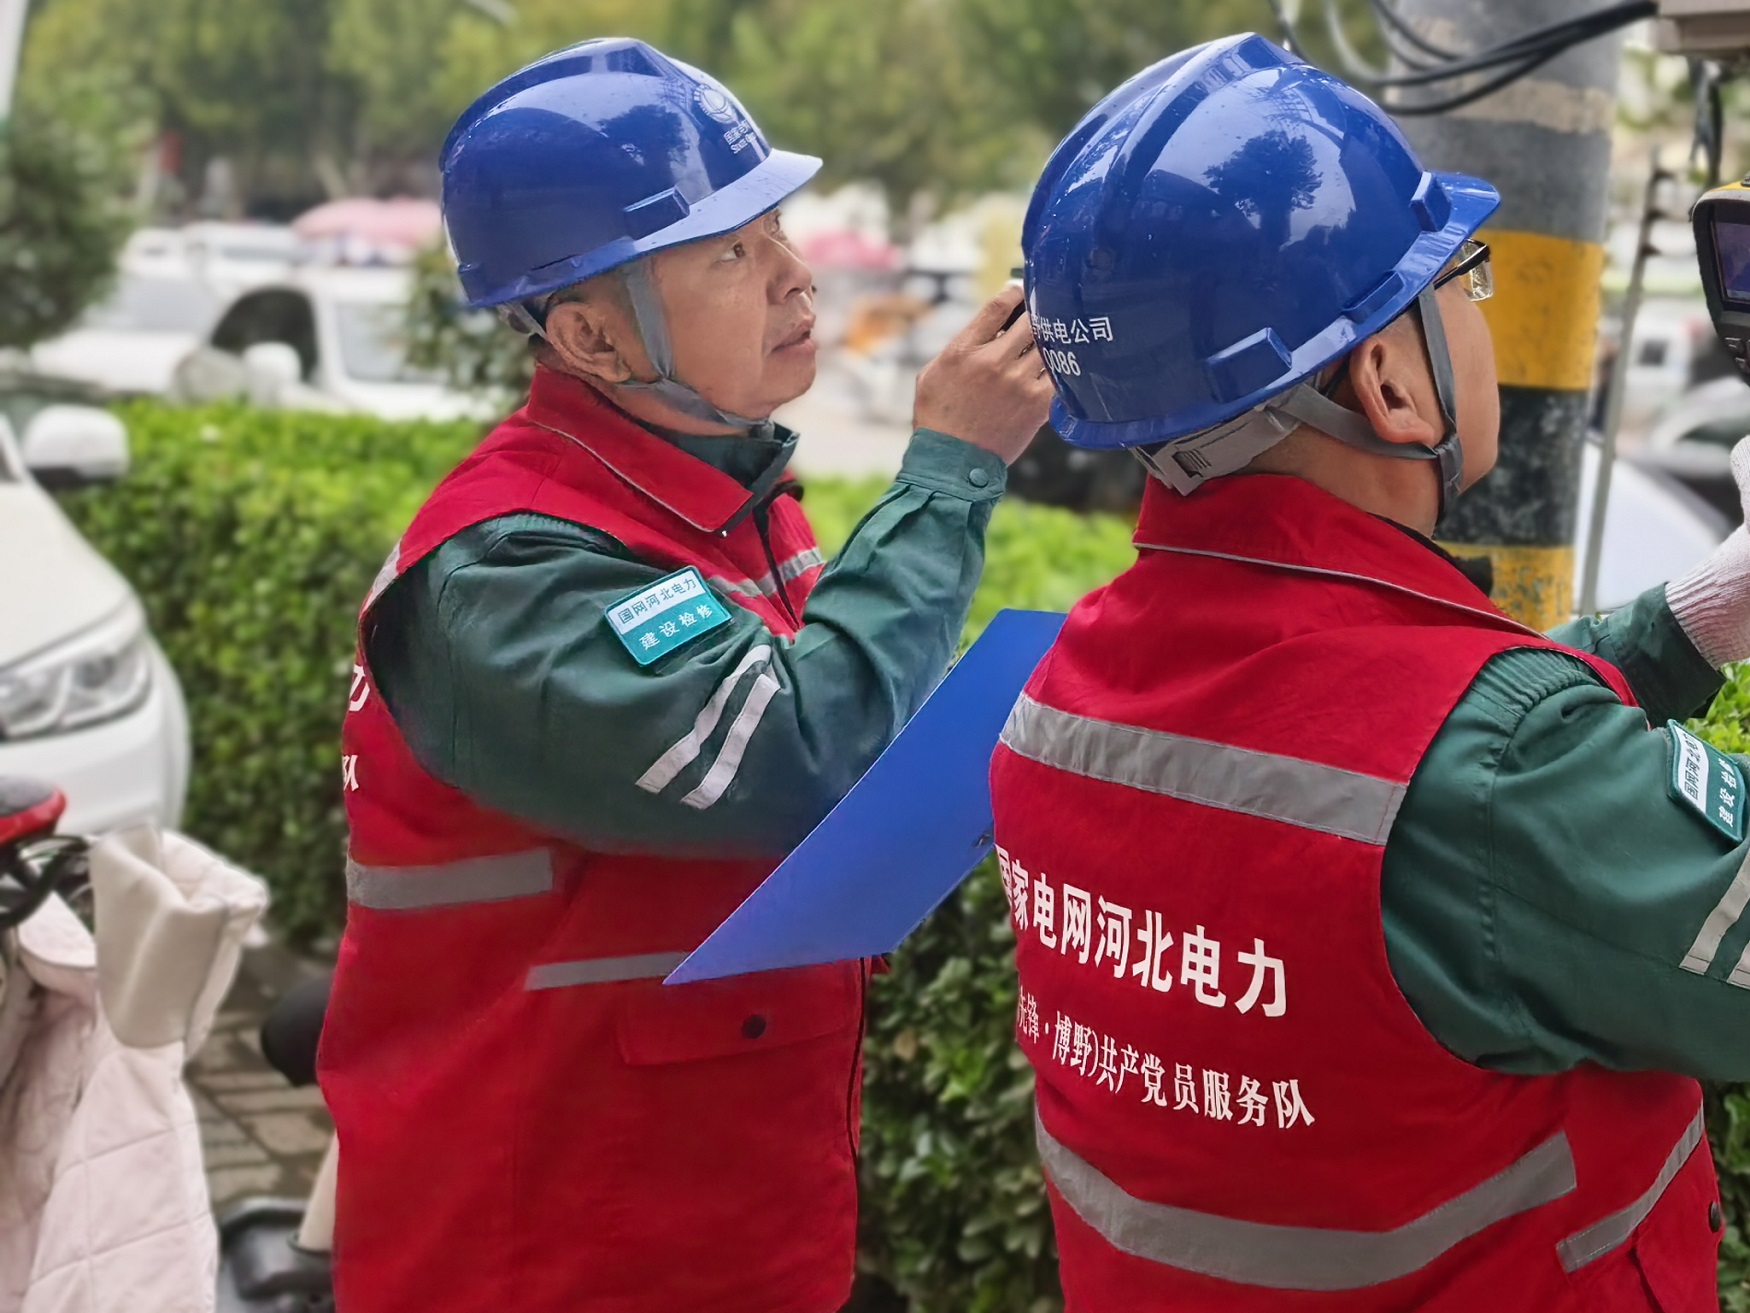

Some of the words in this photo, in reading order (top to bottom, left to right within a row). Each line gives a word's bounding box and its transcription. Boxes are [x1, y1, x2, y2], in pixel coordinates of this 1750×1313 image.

[617, 577, 697, 625] 国网河北电力
[638, 604, 714, 651] 建设检修
